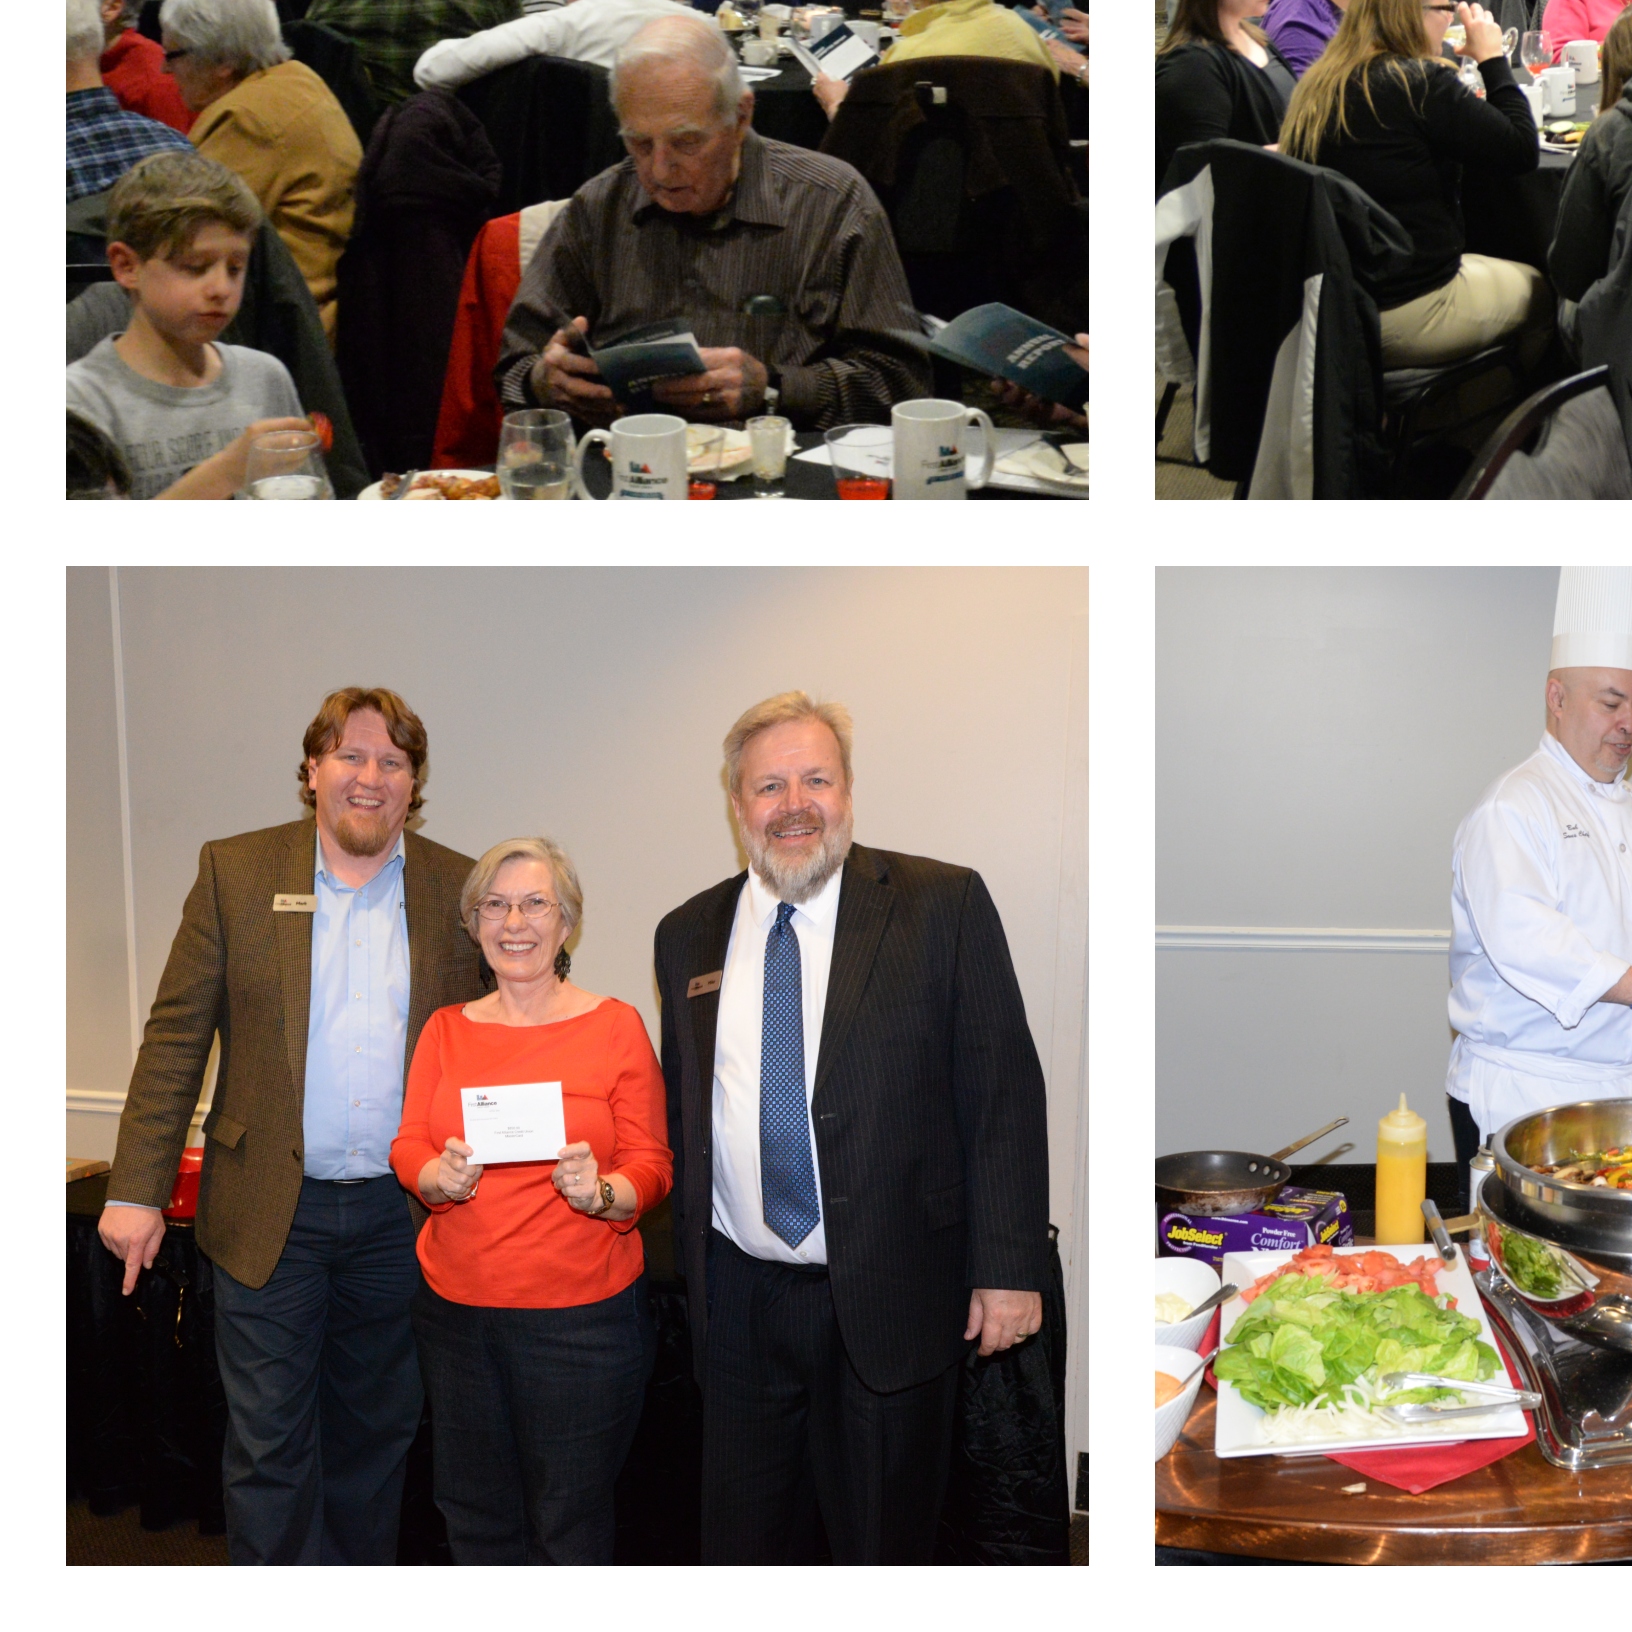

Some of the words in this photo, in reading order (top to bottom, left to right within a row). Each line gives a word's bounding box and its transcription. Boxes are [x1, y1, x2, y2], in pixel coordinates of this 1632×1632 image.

[1167, 1225, 1224, 1246] JobSelect
[1251, 1232, 1301, 1250] Comfort
[1262, 1227, 1283, 1236] Powder
[1284, 1229, 1296, 1238] Free
